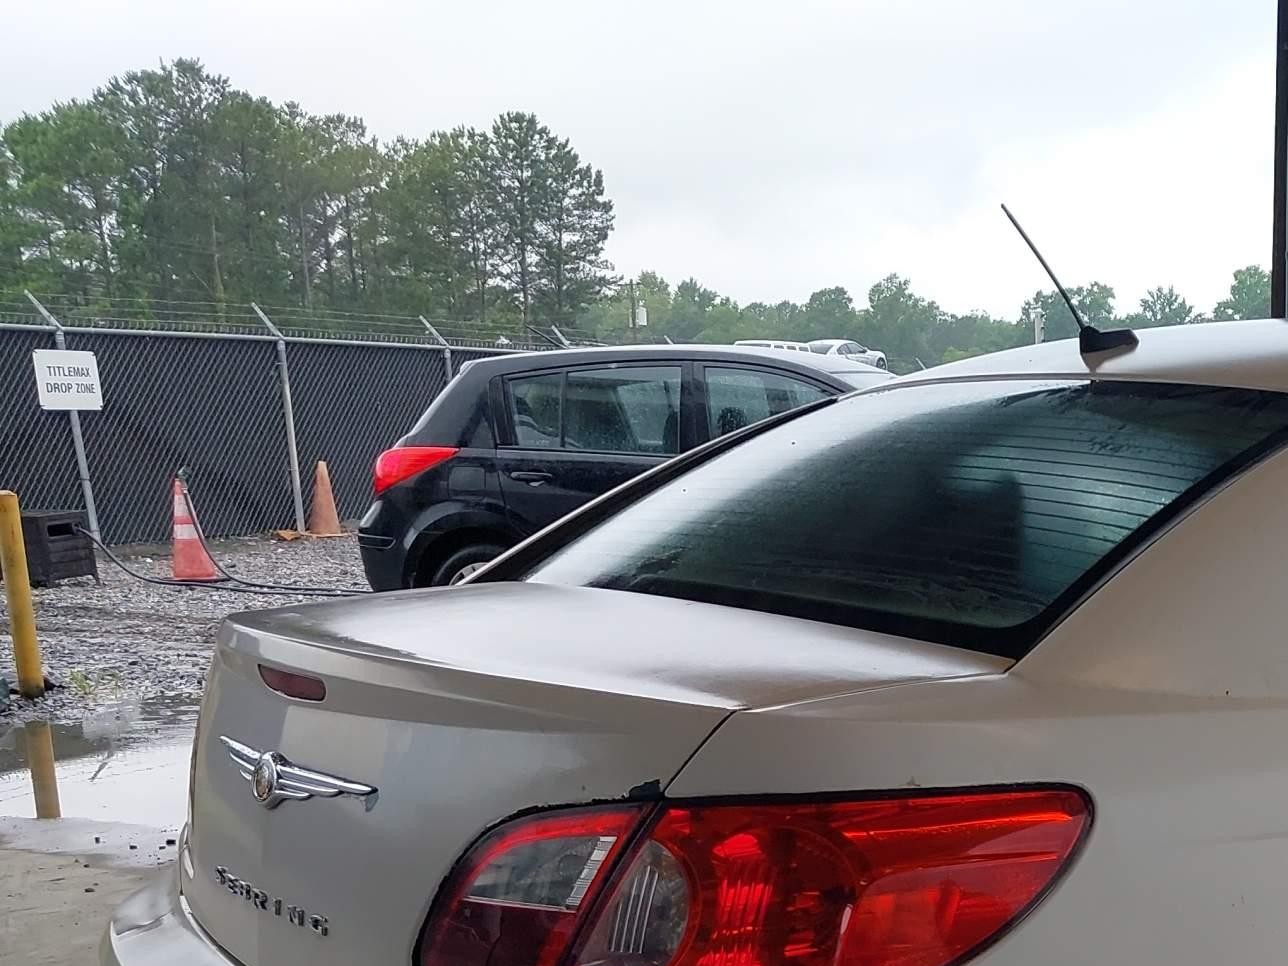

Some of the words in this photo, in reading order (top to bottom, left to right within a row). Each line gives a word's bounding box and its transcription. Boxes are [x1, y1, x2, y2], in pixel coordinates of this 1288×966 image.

[46, 366, 91, 378] TITLEMAX
[46, 382, 73, 394] DROP
[75, 383, 97, 394] ZONE
[215, 864, 329, 937] SEBRING
